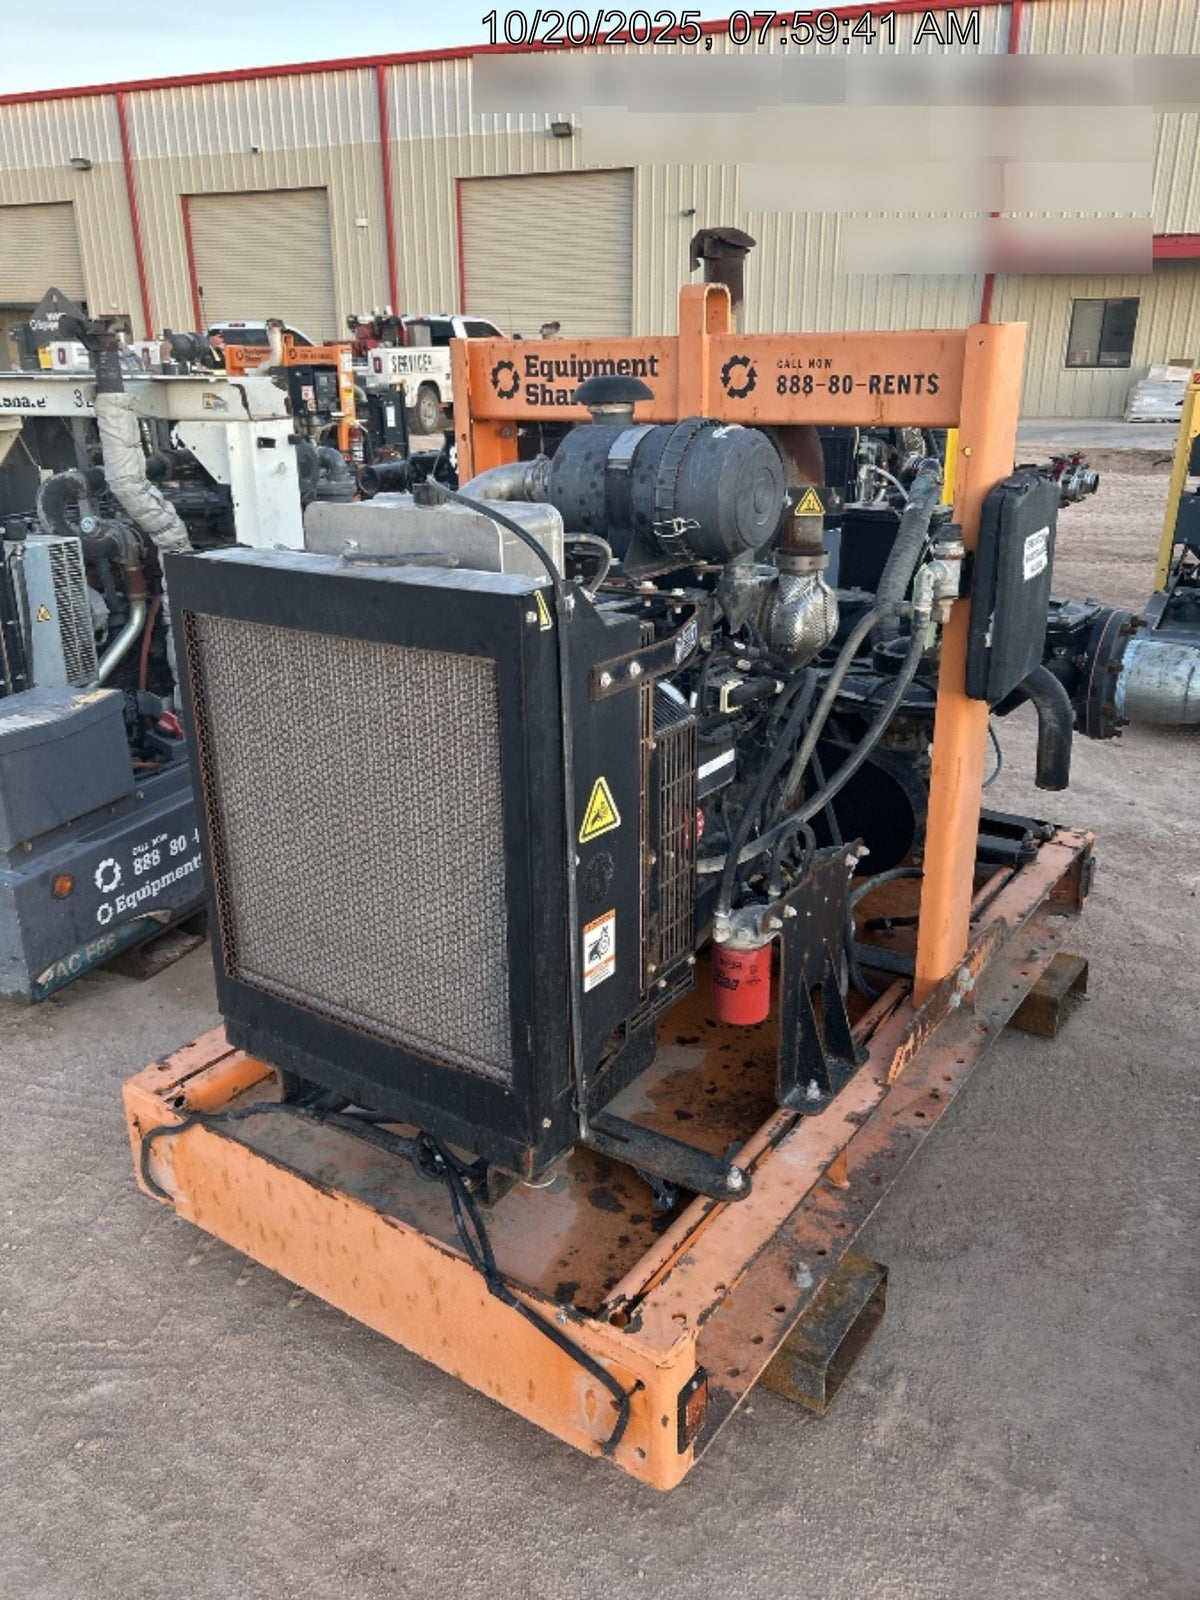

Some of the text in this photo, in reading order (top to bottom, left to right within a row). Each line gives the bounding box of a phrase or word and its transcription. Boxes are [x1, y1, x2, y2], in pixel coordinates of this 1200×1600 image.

[524, 353, 659, 382] Equipment
[776, 358, 833, 369] CALL NOW
[525, 383, 582, 406] Shar
[776, 373, 939, 395] 888-80-RENTS
[133, 848, 161, 875] 888
[169, 834, 187, 856] 80
[114, 851, 202, 914] Equipment
